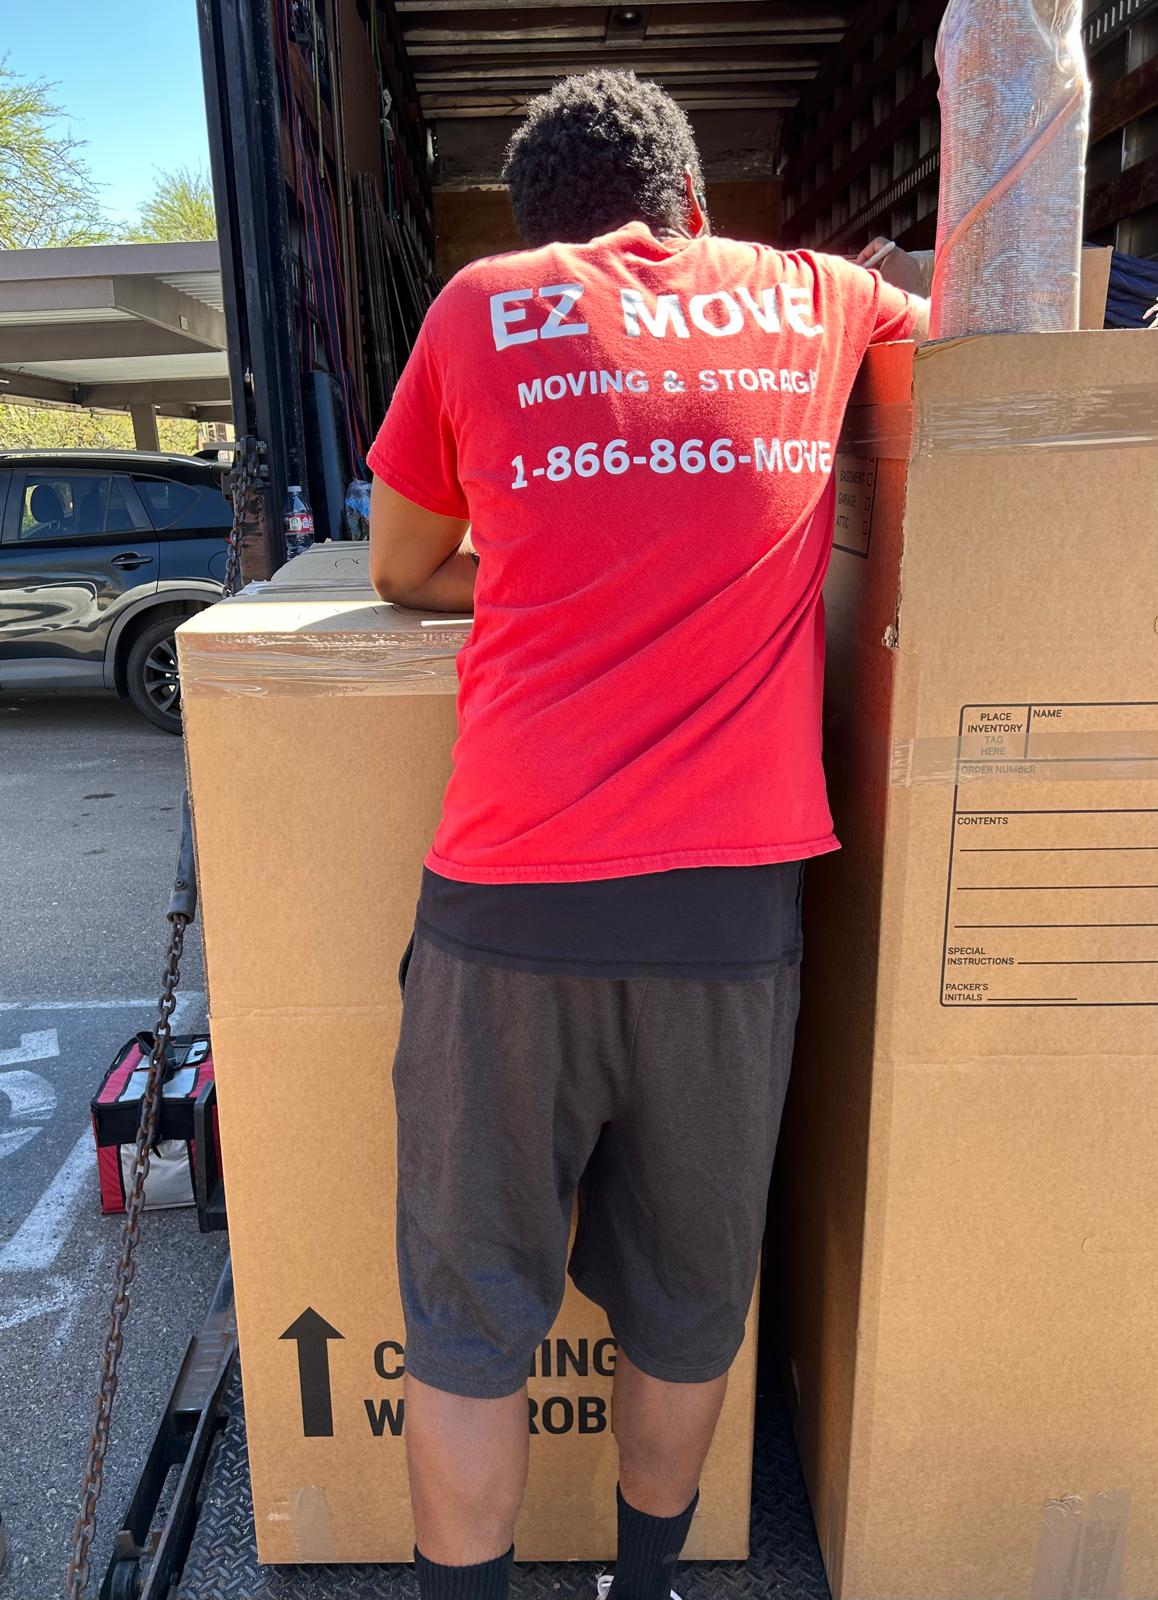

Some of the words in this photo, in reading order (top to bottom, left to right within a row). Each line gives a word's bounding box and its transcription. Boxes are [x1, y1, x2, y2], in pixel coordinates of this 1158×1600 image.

[490, 283, 589, 351] EZ
[620, 282, 824, 338] MOVE
[517, 371, 649, 408] MOVING
[663, 370, 686, 393] &
[511, 437, 832, 490] 1-866-866-MOVE
[980, 712, 1012, 721] PLACE
[1033, 709, 1063, 718] NAME
[967, 724, 1023, 733] INVENTORY
[985, 736, 1004, 744] TAG
[980, 747, 1007, 756] HERE
[961, 765, 993, 774] ORDER
[995, 764, 1037, 774] NUMBER
[957, 817, 1009, 825] CONTENTS
[947, 947, 986, 955] SPECIAL
[947, 957, 1015, 966] INSTRUCTIONS
[945, 983, 989, 991] PACKER'S
[944, 993, 983, 1002] INITIALS
